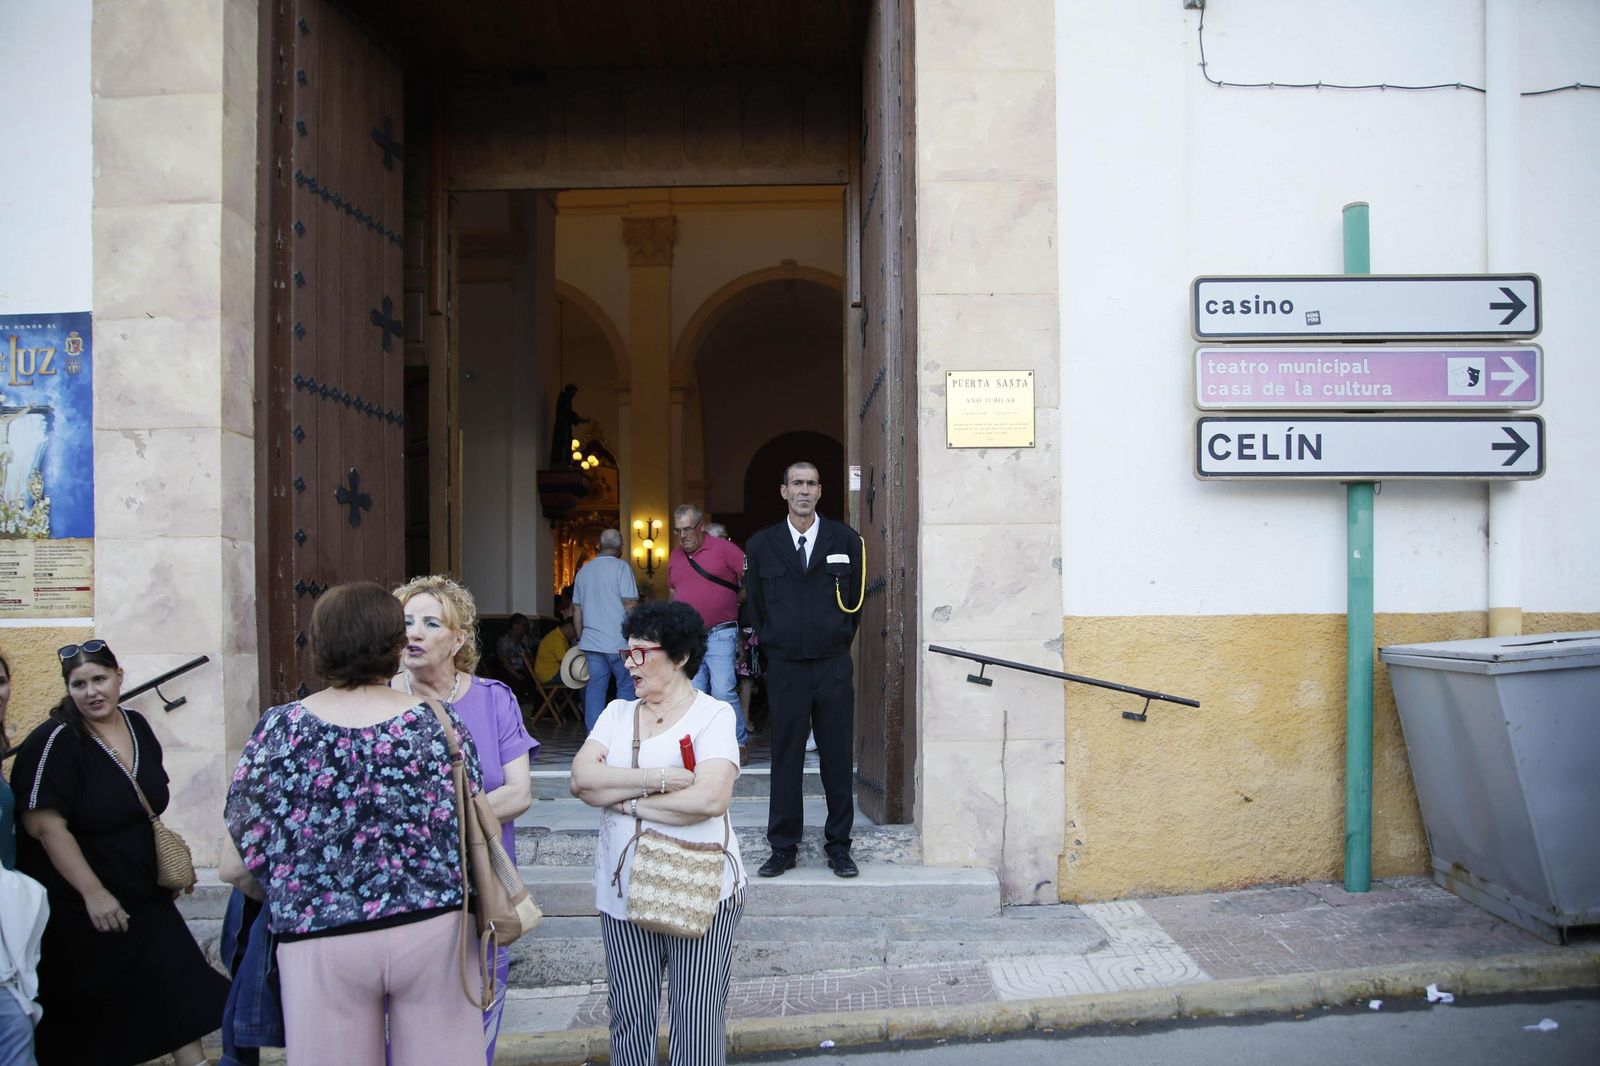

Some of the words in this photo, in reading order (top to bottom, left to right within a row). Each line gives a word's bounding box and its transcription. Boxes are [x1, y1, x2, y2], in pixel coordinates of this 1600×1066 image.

[1205, 294, 1294, 314] casino
[1207, 359, 1269, 374] teatro
[1278, 359, 1370, 377] municipal
[952, 378, 990, 388] PUERTA
[996, 378, 1028, 388] SANTA
[1207, 383, 1252, 396] casa
[1262, 381, 1285, 396] de
[1295, 381, 1313, 396] la
[1323, 381, 1392, 396] cultura
[1208, 427, 1322, 460] CELÍN
